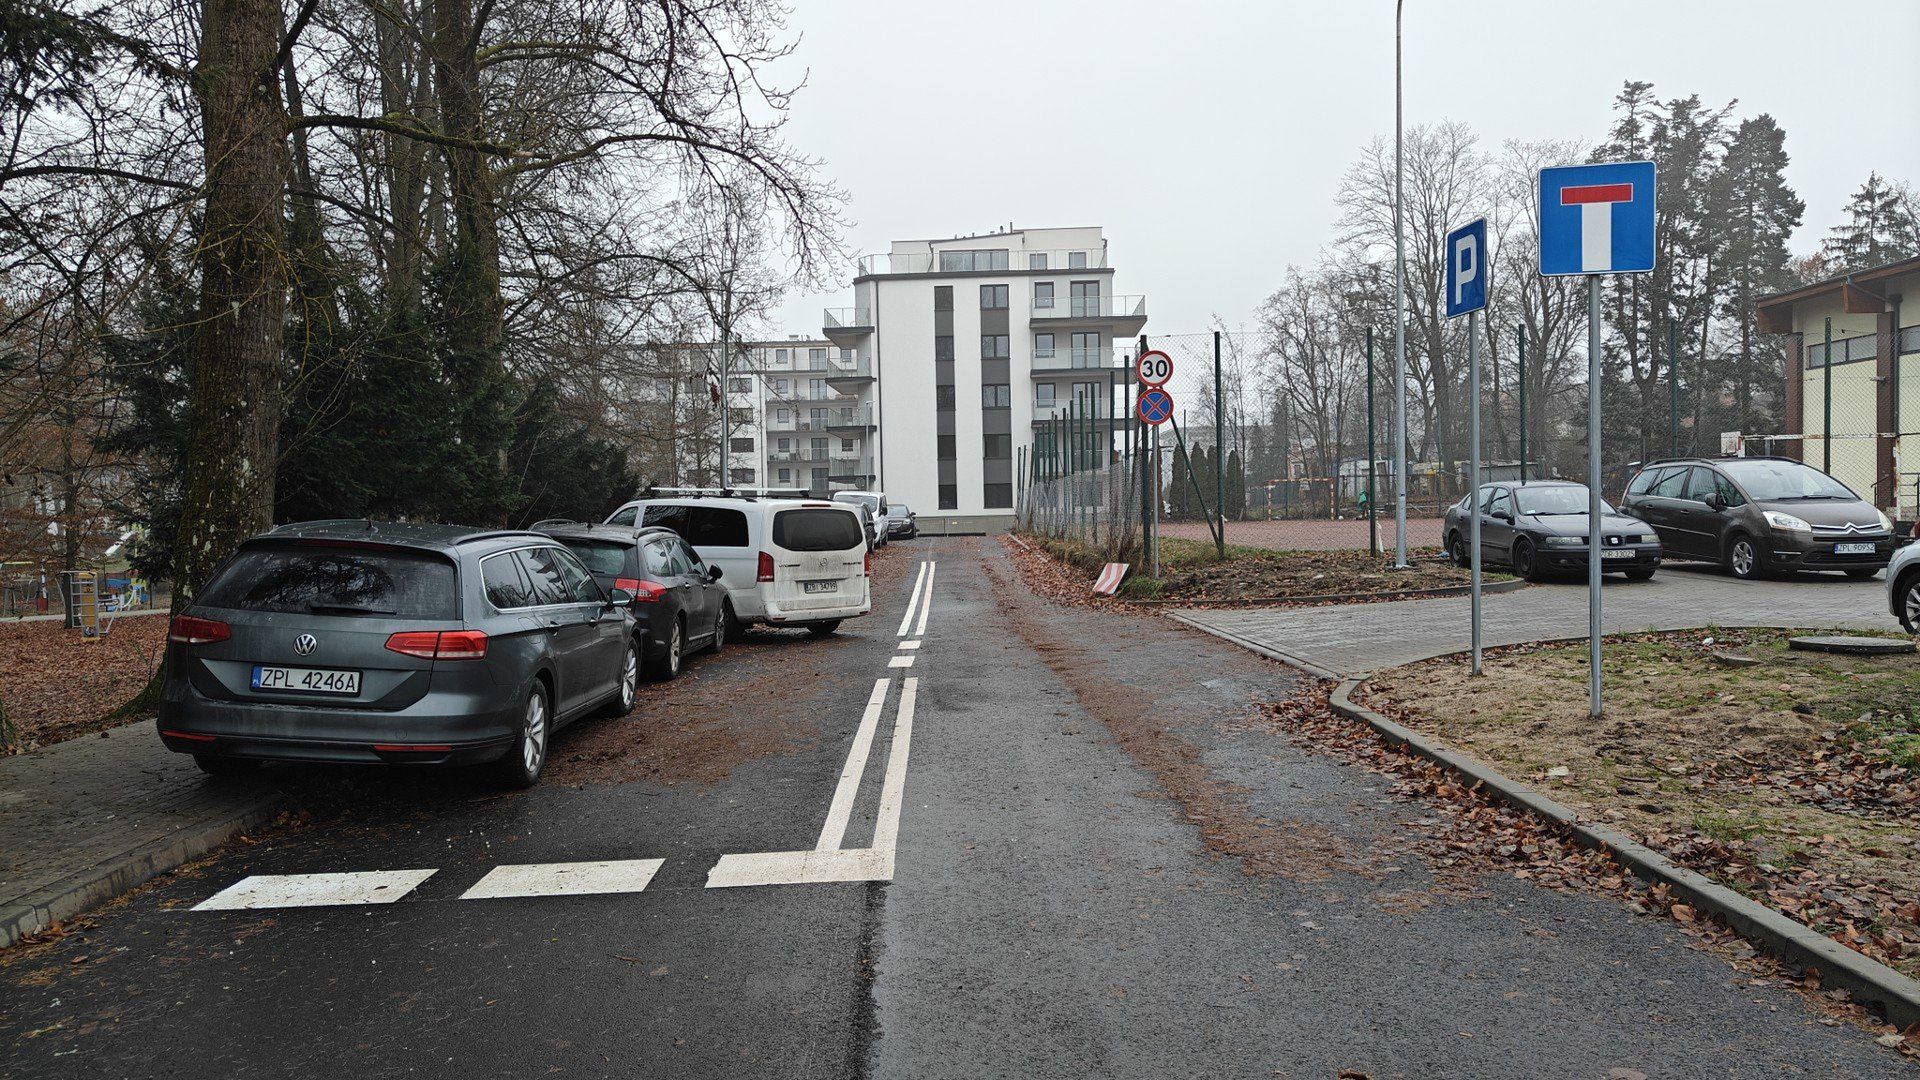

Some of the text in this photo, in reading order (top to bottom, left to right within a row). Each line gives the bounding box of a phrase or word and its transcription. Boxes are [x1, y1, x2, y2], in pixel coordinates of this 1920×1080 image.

[1455, 233, 1477, 306] P
[1142, 359, 1168, 378] 30
[1838, 544, 1852, 552] ZPL
[261, 668, 356, 692] ZPL 4246A
